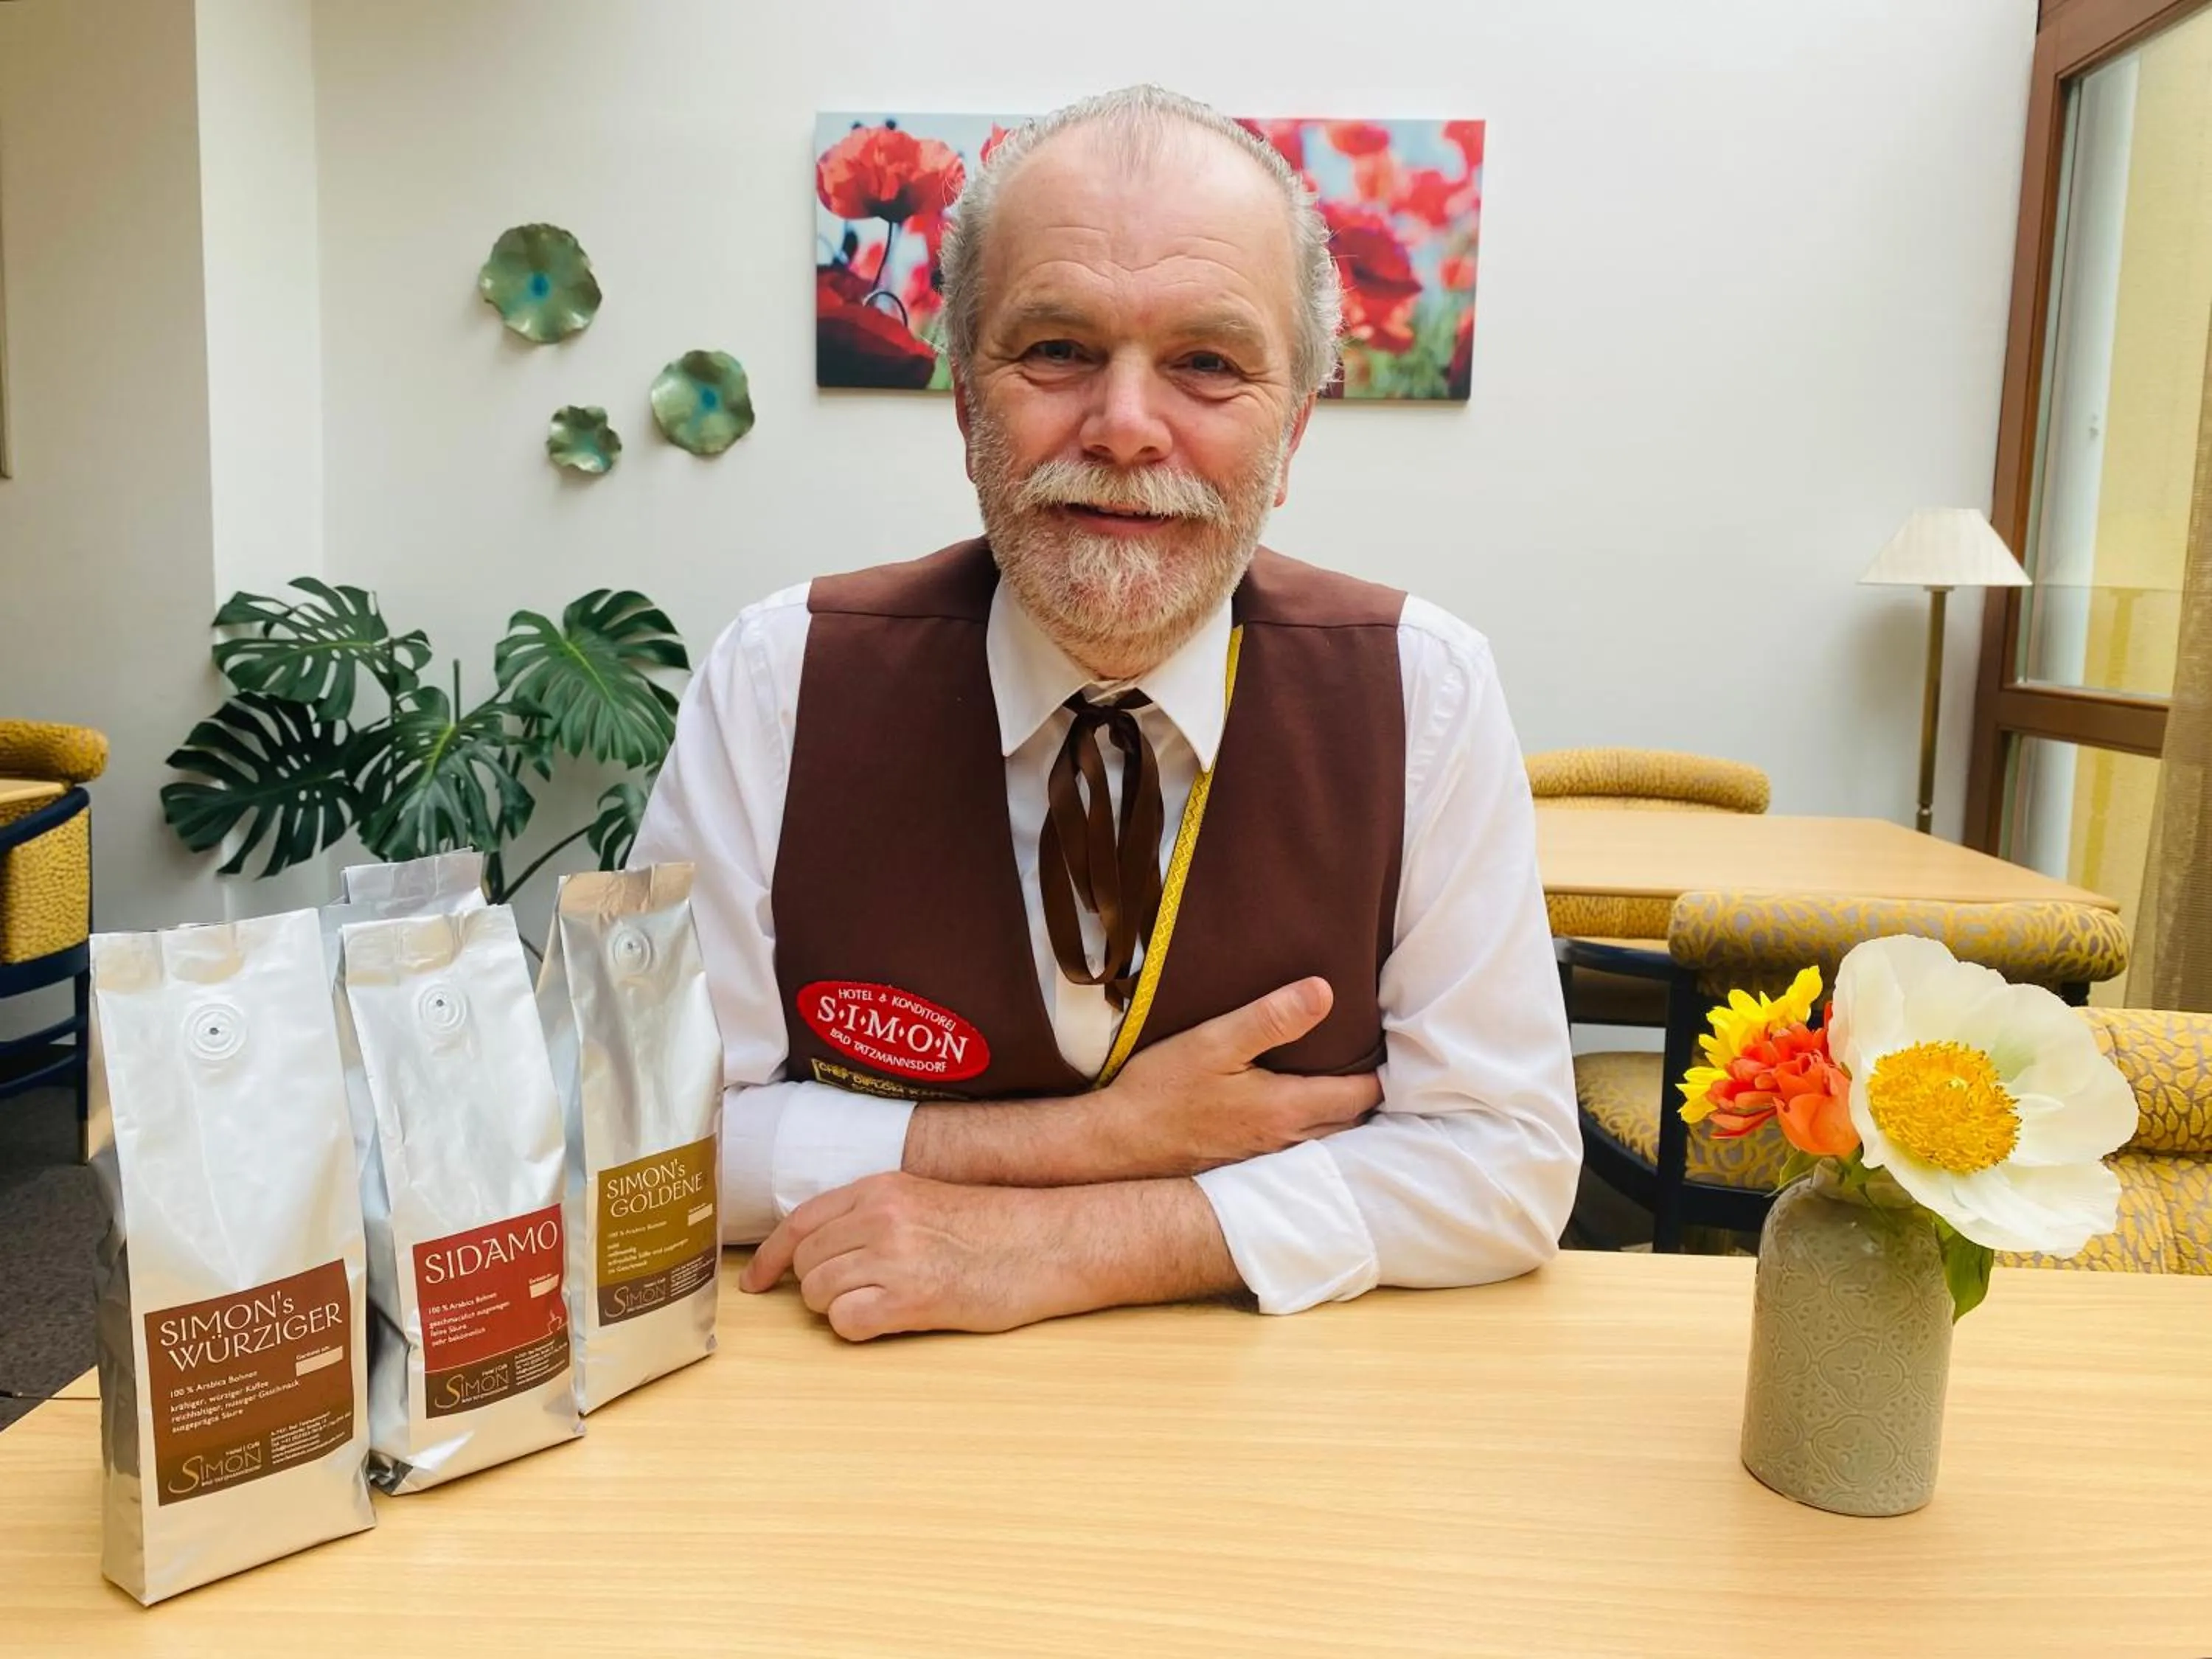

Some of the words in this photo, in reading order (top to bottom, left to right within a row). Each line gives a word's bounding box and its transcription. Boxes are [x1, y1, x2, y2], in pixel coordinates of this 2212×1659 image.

[838, 988, 873, 1001] HOTEL
[878, 992, 888, 1003] &
[891, 995, 956, 1032] KONDITOREI
[830, 1027, 851, 1046] BAD
[853, 1040, 947, 1073] TATZMANNSDORF
[607, 1158, 686, 1199] SIMON's
[610, 1171, 703, 1217] GOLDENE
[425, 1220, 558, 1284] SIDAMO
[160, 1290, 295, 1346] SIMON's
[168, 1302, 344, 1372] WÜRZIGER
[170, 1388, 184, 1399] 100
[186, 1385, 194, 1394] %
[195, 1379, 226, 1392] Arabica
[228, 1371, 258, 1384] Bohnen
[246, 1380, 269, 1393] Kaffee
